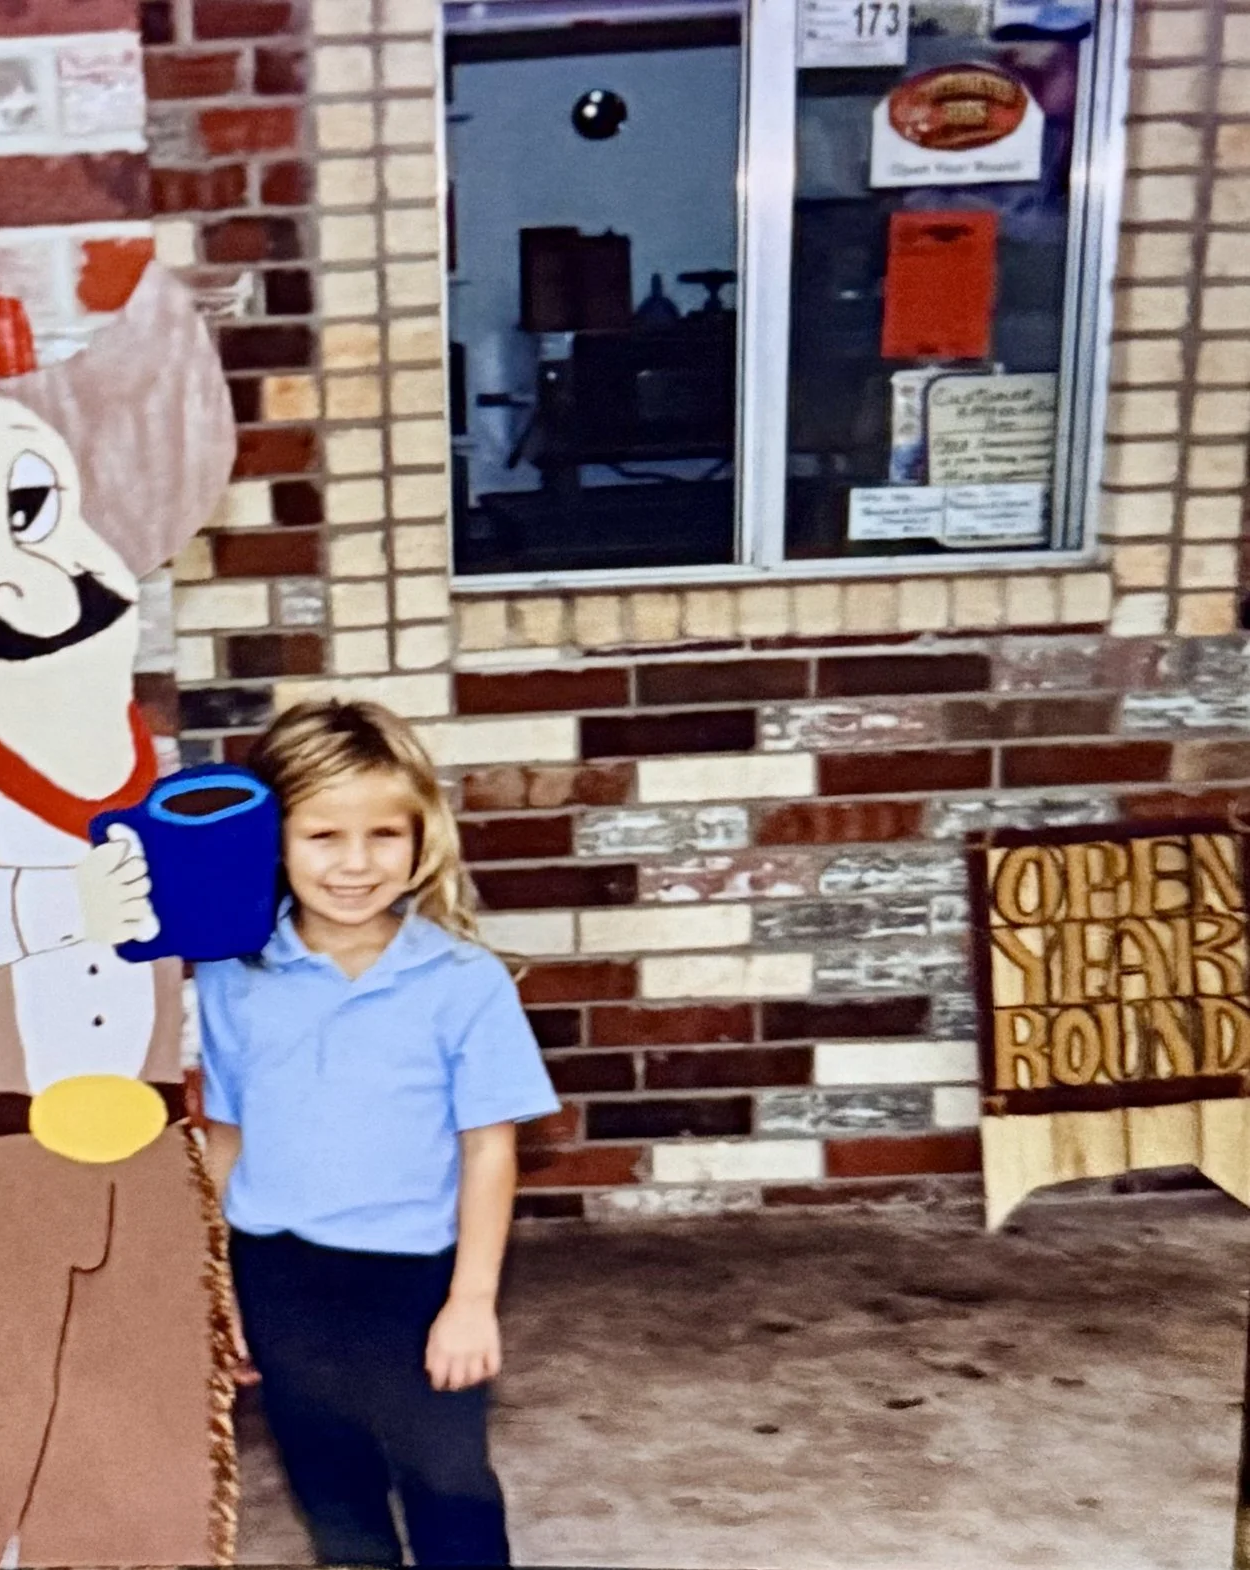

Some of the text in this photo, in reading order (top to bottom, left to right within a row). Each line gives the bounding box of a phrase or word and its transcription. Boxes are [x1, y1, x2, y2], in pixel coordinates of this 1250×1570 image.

[853, 2, 900, 37] 173
[994, 834, 1244, 926] OPEN
[990, 914, 1244, 1006] YEAR
[994, 998, 1250, 1092] ROUND
